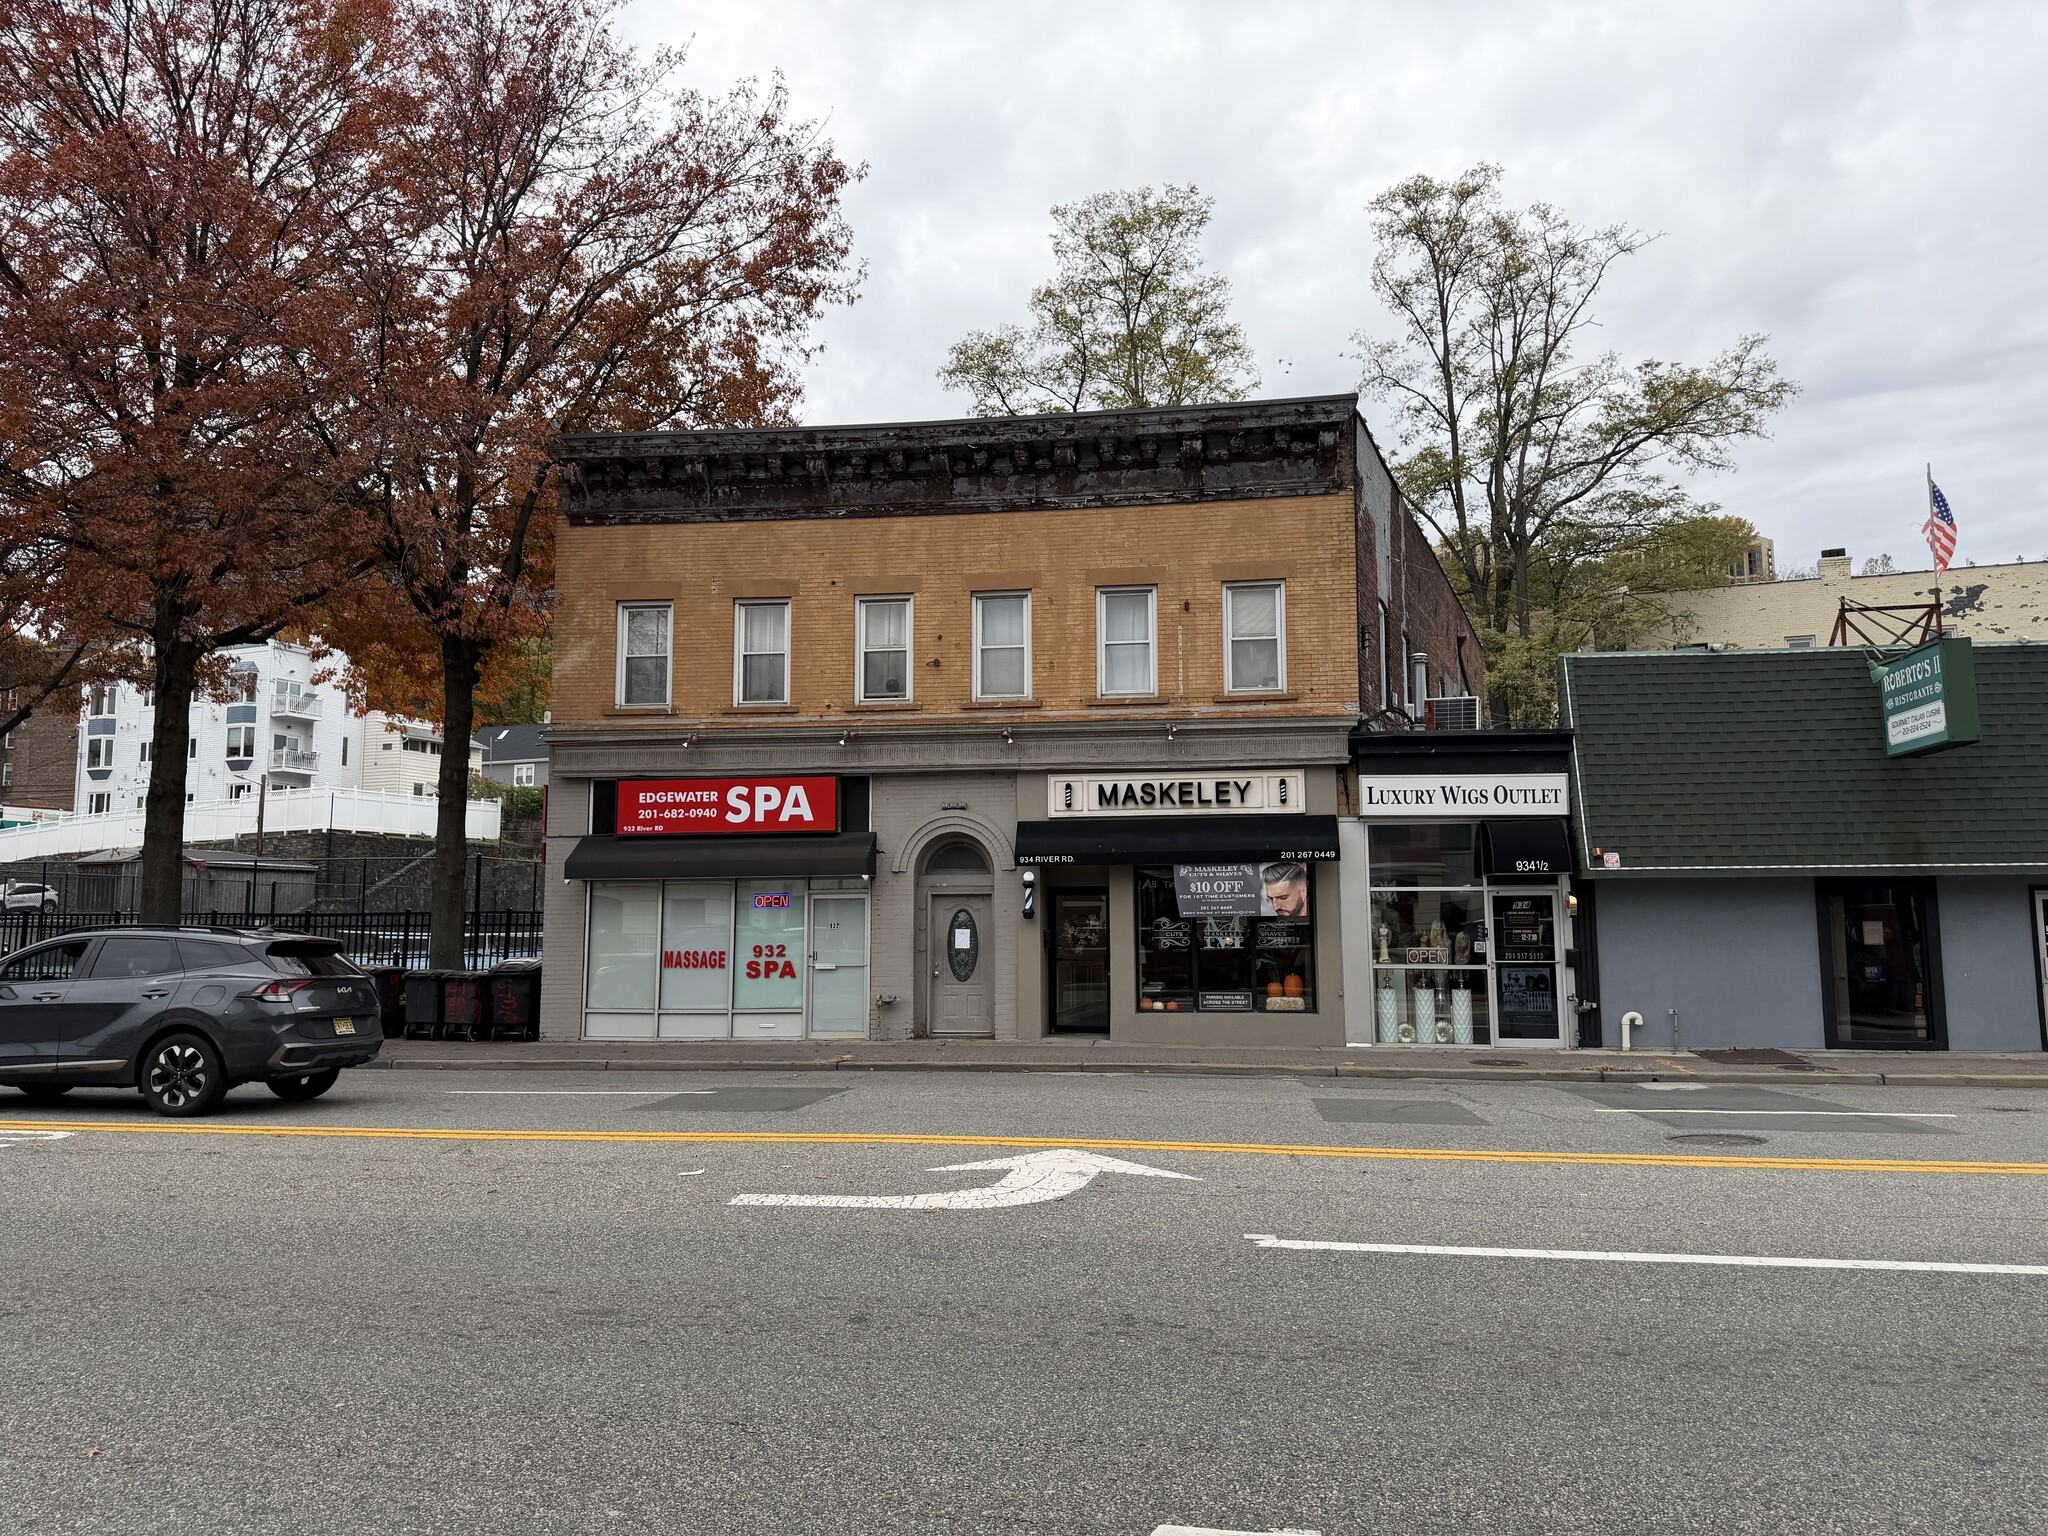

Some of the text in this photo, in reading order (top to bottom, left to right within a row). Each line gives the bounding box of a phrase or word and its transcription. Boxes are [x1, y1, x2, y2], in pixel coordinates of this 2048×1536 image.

[1883, 655, 1941, 692] ROBERTO'S II
[1894, 684, 1934, 707] RISTORANTE
[1891, 707, 1941, 729] GOURMET ITALIAN CUISINE
[1902, 720, 1931, 735] 201-224-2524
[639, 791, 718, 804] EDGEWATER
[1098, 781, 1251, 806] MASKELEY
[1367, 784, 1561, 805] LUXURY WIGS OUTLET
[725, 785, 814, 824] SPA
[638, 808, 717, 819] 201-682-0940
[1035, 855, 1060, 863] RIVER
[1061, 855, 1075, 863] RD.
[1314, 850, 1336, 858] 0449
[1189, 880, 1210, 893] $10
[1213, 880, 1244, 893] OFF
[755, 895, 789, 908] OPEN
[752, 944, 786, 958] 932
[1409, 949, 1446, 963] OPEN
[663, 950, 726, 969] MASSAGE
[746, 960, 797, 979] SPA
